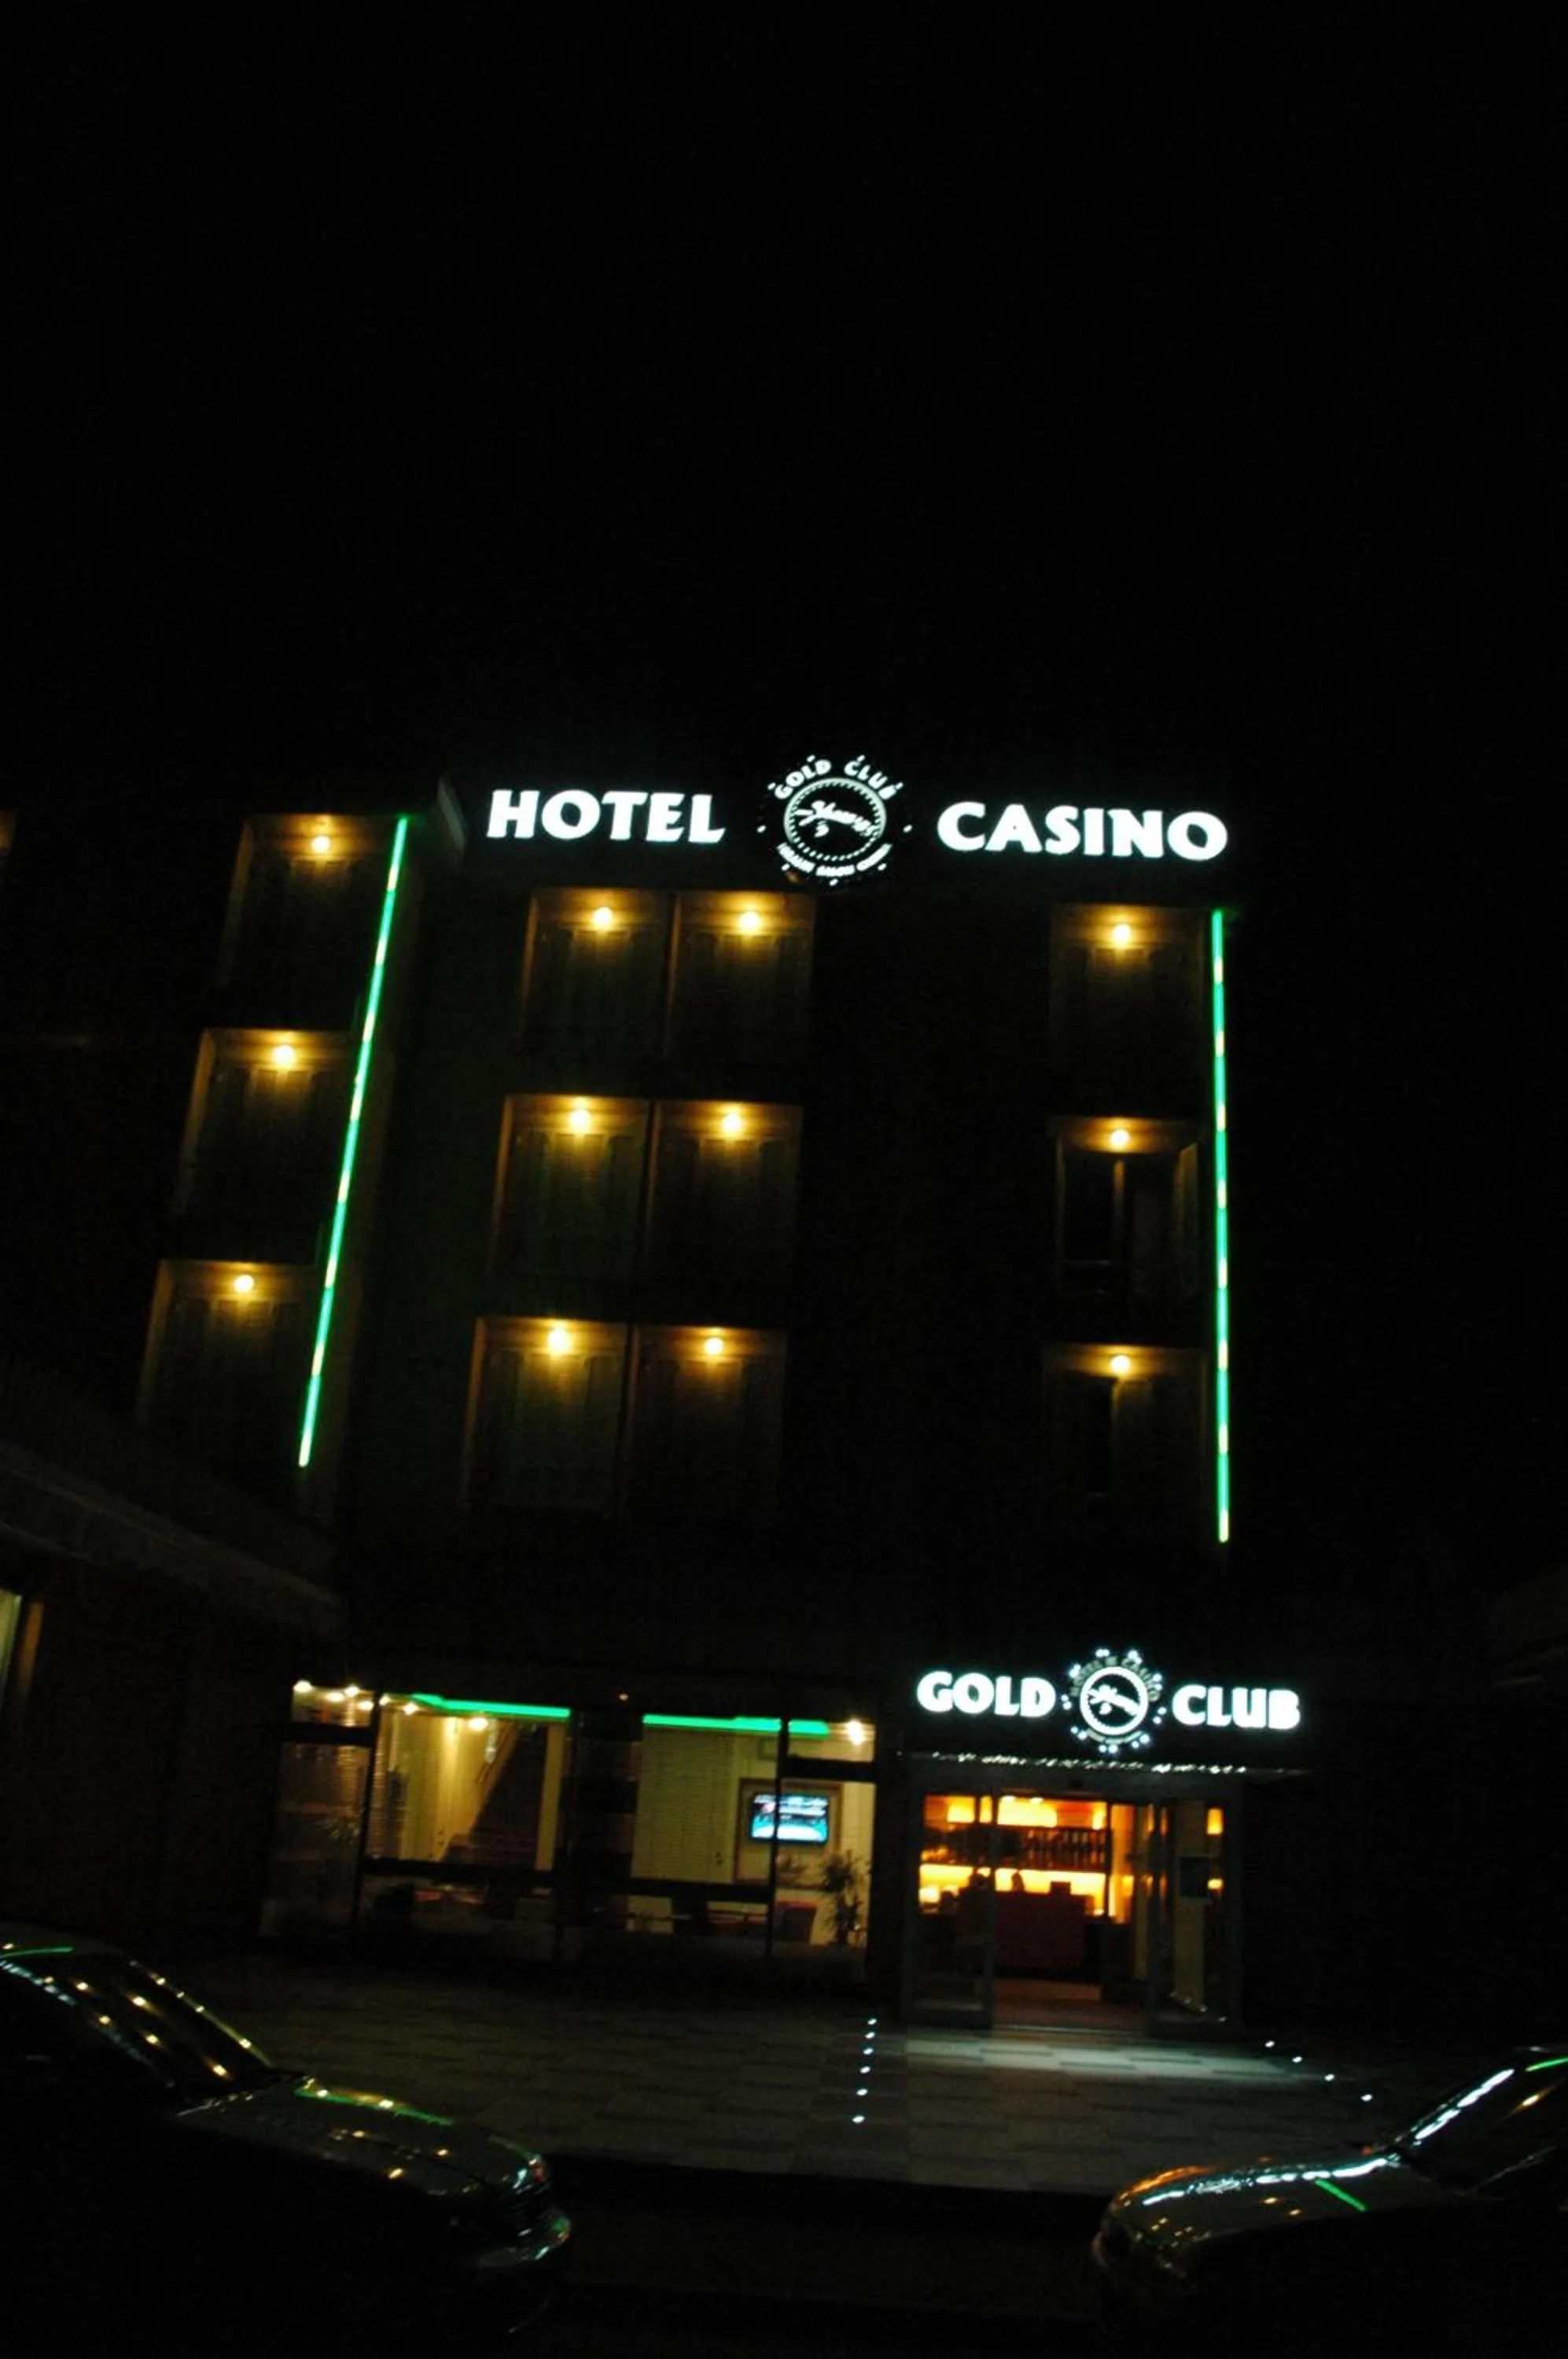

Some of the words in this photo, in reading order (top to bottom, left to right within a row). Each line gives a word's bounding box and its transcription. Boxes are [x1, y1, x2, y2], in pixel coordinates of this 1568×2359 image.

[774, 759, 831, 800] GOLD
[844, 759, 898, 800] CLUB
[486, 789, 726, 844] HOTEL
[937, 801, 1228, 861] CASINO
[916, 1670, 1057, 1717] GOLD
[1172, 1684, 1301, 1731] CLUB
